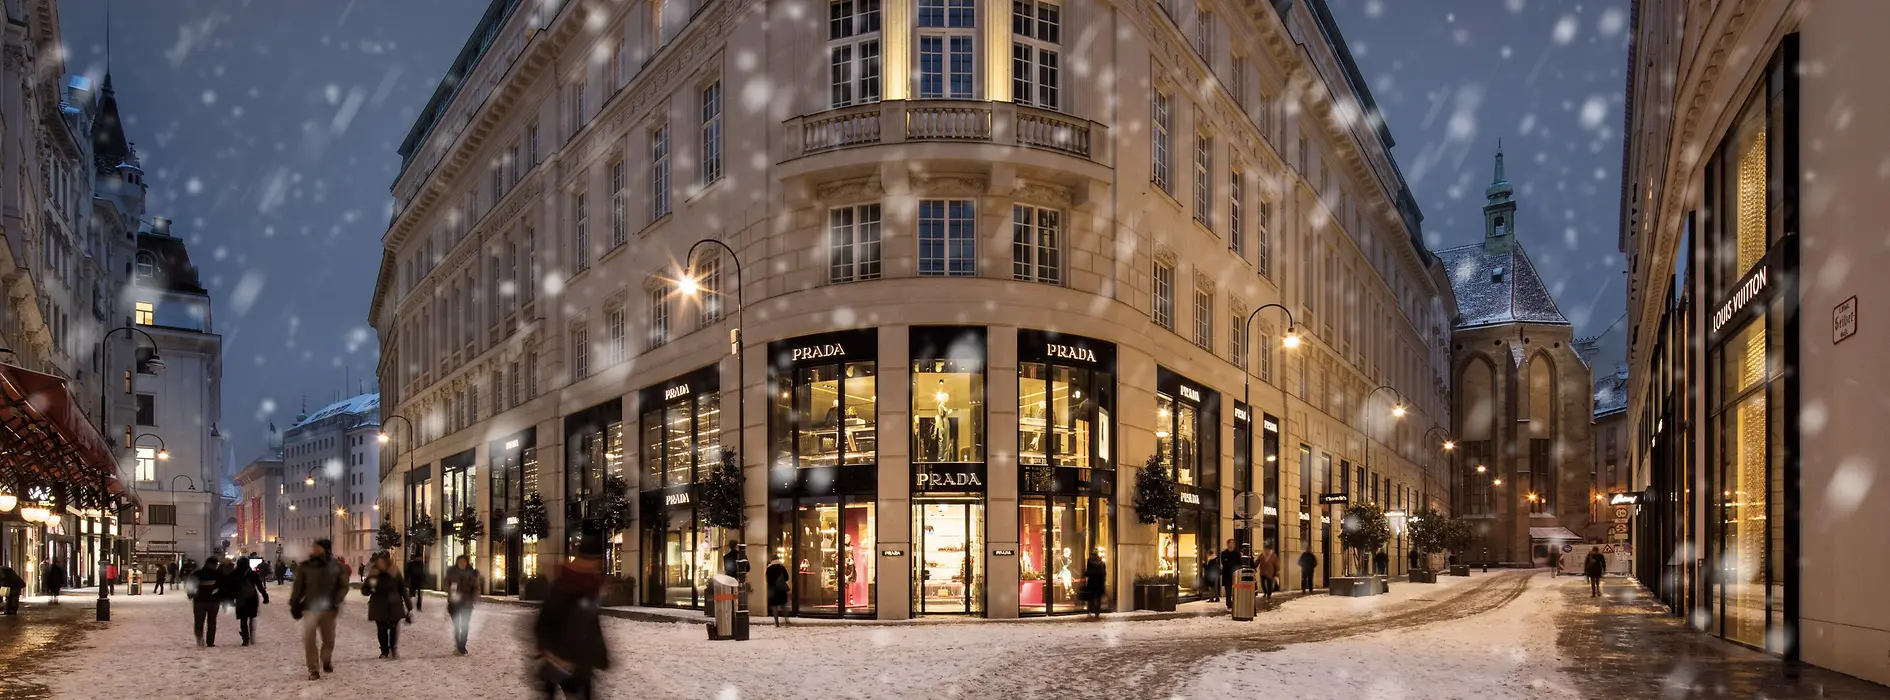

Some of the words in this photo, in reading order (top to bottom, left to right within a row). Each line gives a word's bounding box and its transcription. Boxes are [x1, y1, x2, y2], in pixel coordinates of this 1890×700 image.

[1713, 300, 1731, 333] LOUIS
[1733, 265, 1766, 313] VUITTON
[792, 343, 845, 361] PRADA
[1047, 343, 1097, 363] PRADA
[665, 383, 689, 401] PRADA
[1180, 384, 1200, 402] PRADA
[917, 472, 981, 486] PRADA
[665, 492, 690, 506] PRADA
[1180, 492, 1200, 504] PRADA
